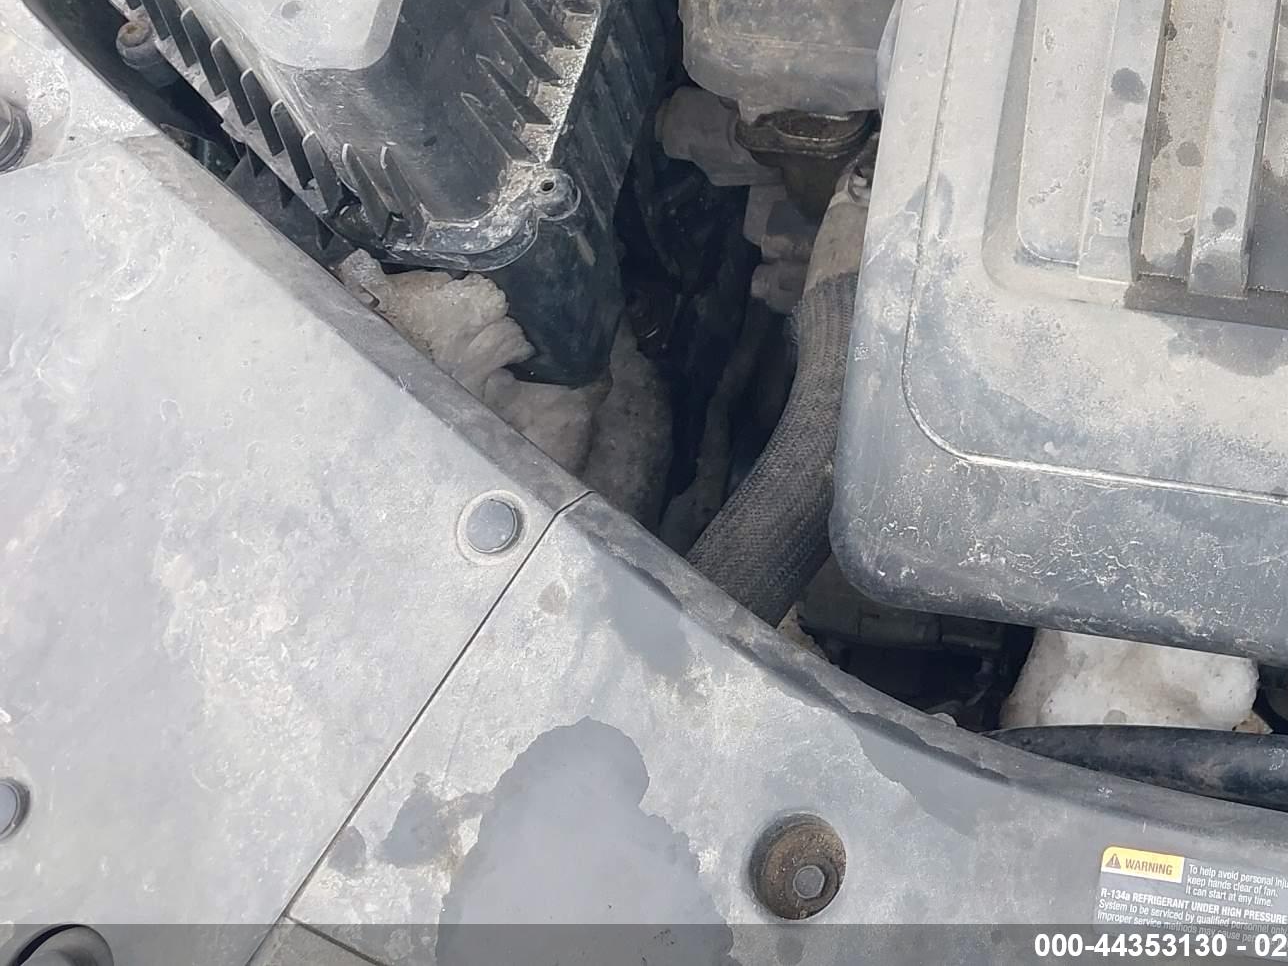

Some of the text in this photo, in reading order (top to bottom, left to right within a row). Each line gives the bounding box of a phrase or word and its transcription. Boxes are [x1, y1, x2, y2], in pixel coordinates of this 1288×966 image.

[1125, 858, 1173, 875] WARNING
[1189, 864, 1198, 874] To
[1200, 865, 1216, 878] help
[1218, 866, 1239, 880] avoid
[1240, 873, 1274, 886] personal
[1187, 875, 1278, 897] keep hands clear of fan.
[1192, 887, 1207, 896] can
[1208, 889, 1226, 900] start
[1228, 892, 1236, 901] at
[1238, 895, 1253, 906] any
[1254, 895, 1273, 907] time.
[1099, 899, 1128, 912] System
[1129, 903, 1137, 913] to
[1140, 905, 1149, 914] be
[1151, 906, 1183, 920] serviced
[1185, 912, 1195, 923] by
[1196, 914, 1230, 927] qualified
[1231, 920, 1269, 933] personnel
[1101, 888, 1288, 924] R-134a REFRIGERANT UNDER HIGH PRESSURE
[1098, 910, 1132, 925] Improper
[1134, 916, 1161, 929] service
[1164, 921, 1197, 934] methods
